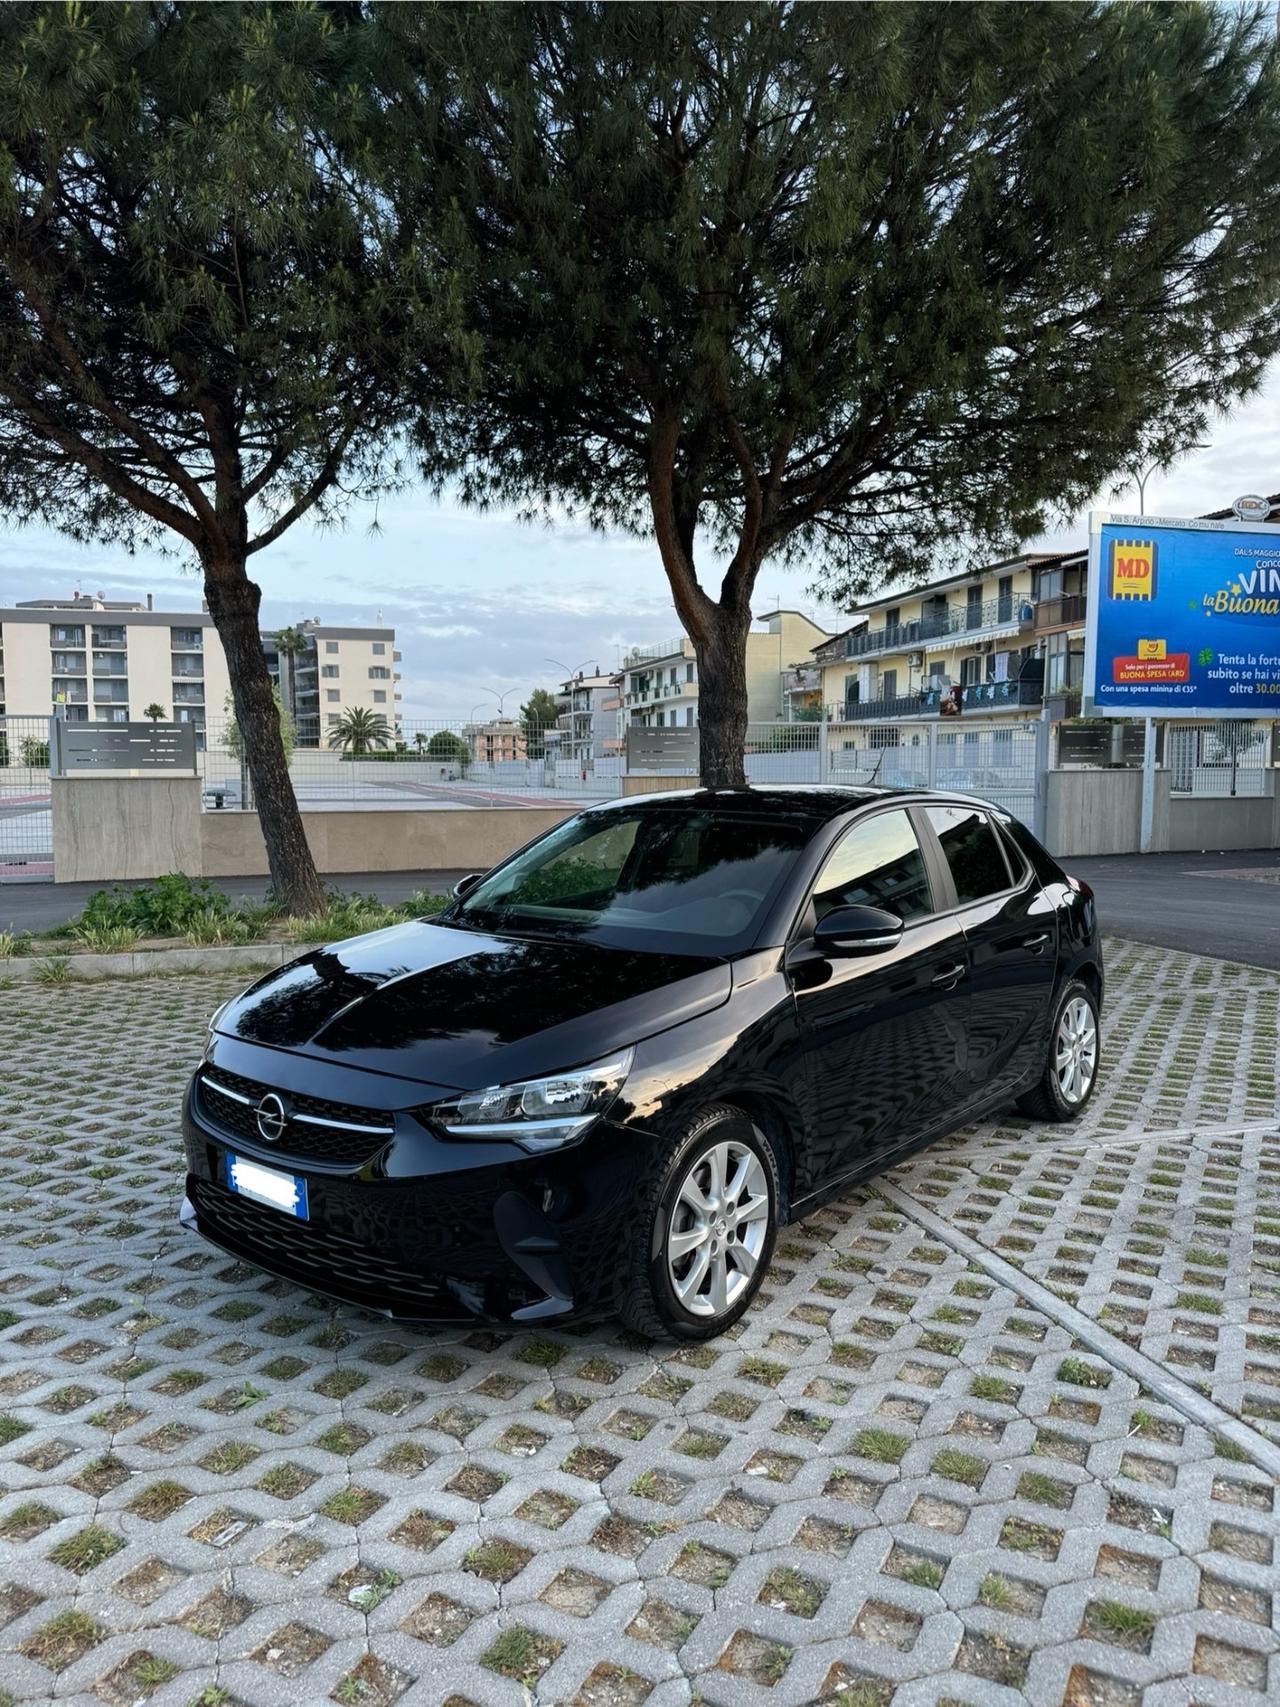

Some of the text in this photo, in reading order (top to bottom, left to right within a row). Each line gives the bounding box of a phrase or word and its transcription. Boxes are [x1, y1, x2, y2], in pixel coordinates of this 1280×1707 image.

[1110, 514, 1122, 523] Via
[1132, 516, 1154, 526] Arpino
[1234, 548, 1247, 556] DAL
[1116, 558, 1150, 579] MD
[1203, 590, 1280, 615] la Buona
[1217, 653, 1245, 665] Tenta
[1247, 653, 1257, 665] la
[1119, 669, 1185, 679] BUONA SPESA CARD
[1207, 667, 1239, 679] subito
[1241, 671, 1253, 680] se
[1254, 667, 1269, 680] hai
[1100, 684, 1115, 692] Con
[1130, 686, 1149, 694] spesa
[1174, 684, 1181, 693] di
[1229, 682, 1254, 694] oltre
